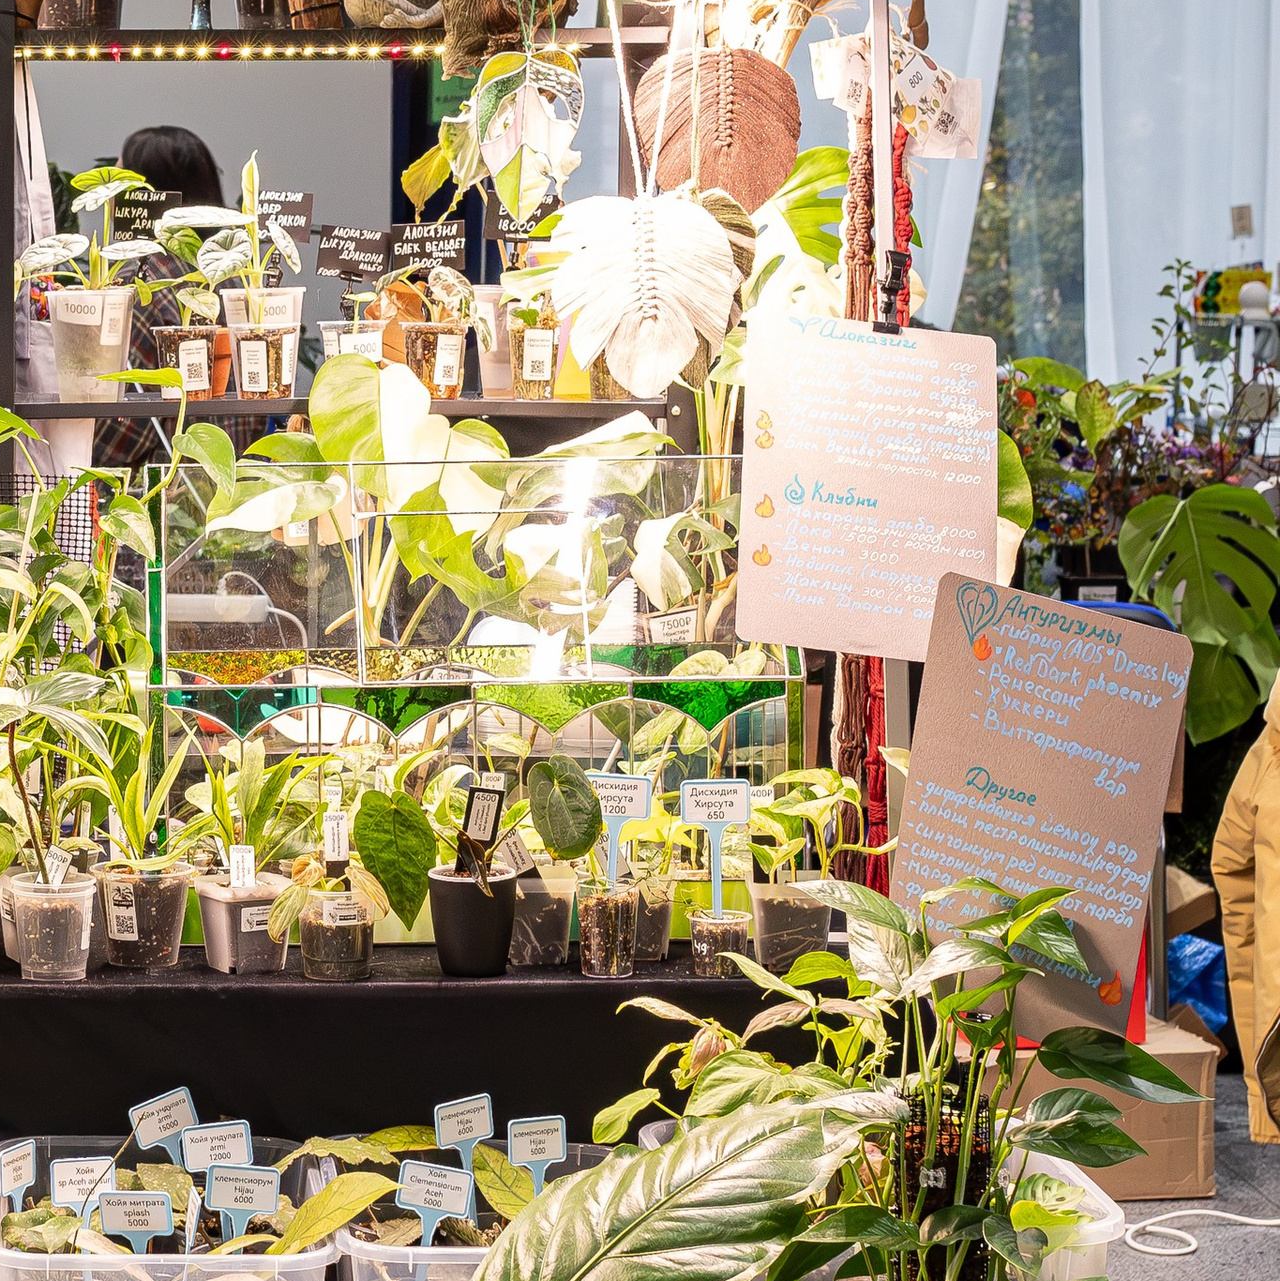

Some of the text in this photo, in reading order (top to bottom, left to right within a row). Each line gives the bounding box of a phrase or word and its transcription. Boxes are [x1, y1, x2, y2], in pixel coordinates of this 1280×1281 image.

[909, 71, 923, 88] 800
[124, 191, 166, 201] АЛОКАЗИЯ
[115, 207, 148, 218] ШКУРА
[266, 215, 306, 227] ДРАКОН
[115, 231, 133, 240] 1000
[332, 227, 381, 240] АЛОКАЗИЯ
[403, 224, 457, 239] АЛОКАЗИЯ
[321, 238, 355, 250] ШКУРА
[394, 239, 465, 254] БЛЕК ВЕЛЬВЕТ
[339, 250, 383, 263] ДРАКОНА
[317, 268, 340, 277] 5000
[64, 302, 96, 315] 10000
[820, 320, 917, 349] Алоказии
[353, 342, 377, 353] 5000
[947, 362, 977, 373] 1000
[943, 472, 982, 484] 12000
[812, 480, 878, 508] Клубни
[840, 532, 877, 544] 1500
[939, 527, 977, 540] 8000
[858, 550, 899, 564] 3000
[996, 595, 1122, 645] Антуриумы
[988, 663, 1085, 712] Ренессанс
[1085, 677, 1163, 709] phoenix
[986, 685, 1069, 727] Хуккери
[592, 781, 638, 792] Дисхидия
[965, 767, 1037, 806] Другое
[1093, 767, 1127, 799] вар
[476, 793, 496, 803] 4500
[690, 787, 738, 798] Дисхидия
[604, 804, 626, 814] 1200
[694, 798, 734, 809] Хирсута
[707, 811, 724, 820] 650
[919, 800, 968, 828] плющ
[1104, 841, 1138, 864] вар
[1005, 853, 1037, 872] ред
[156, 1097, 187, 1116] ундулата
[441, 1105, 486, 1121] клеменсиорум
[157, 1114, 172, 1124] armi
[158, 1120, 179, 1132] 15000
[457, 1126, 474, 1135] 6000
[189, 1131, 243, 1144] Хойя ундулата
[514, 1127, 559, 1138] клеменсиорум
[210, 1143, 226, 1152] armi
[530, 1138, 546, 1146] Hijau
[209, 1152, 231, 1160] 12000
[530, 1147, 546, 1155] 5000
[75, 1166, 94, 1176] Хойя
[428, 1169, 447, 1179] Хойя
[68, 1177, 88, 1185] Aceh
[215, 1176, 273, 1187] клеменсиорум
[410, 1175, 462, 1192] Clemensiorum
[77, 1187, 95, 1196] 7000
[234, 1186, 254, 1195] Hijau
[425, 1189, 444, 1198] Aceh
[105, 1199, 165, 1209] Хойя митрата
[234, 1195, 254, 1203] 6000
[423, 1197, 442, 1207] 5000
[123, 1209, 150, 1217] splash
[127, 1219, 149, 1227] 5000
